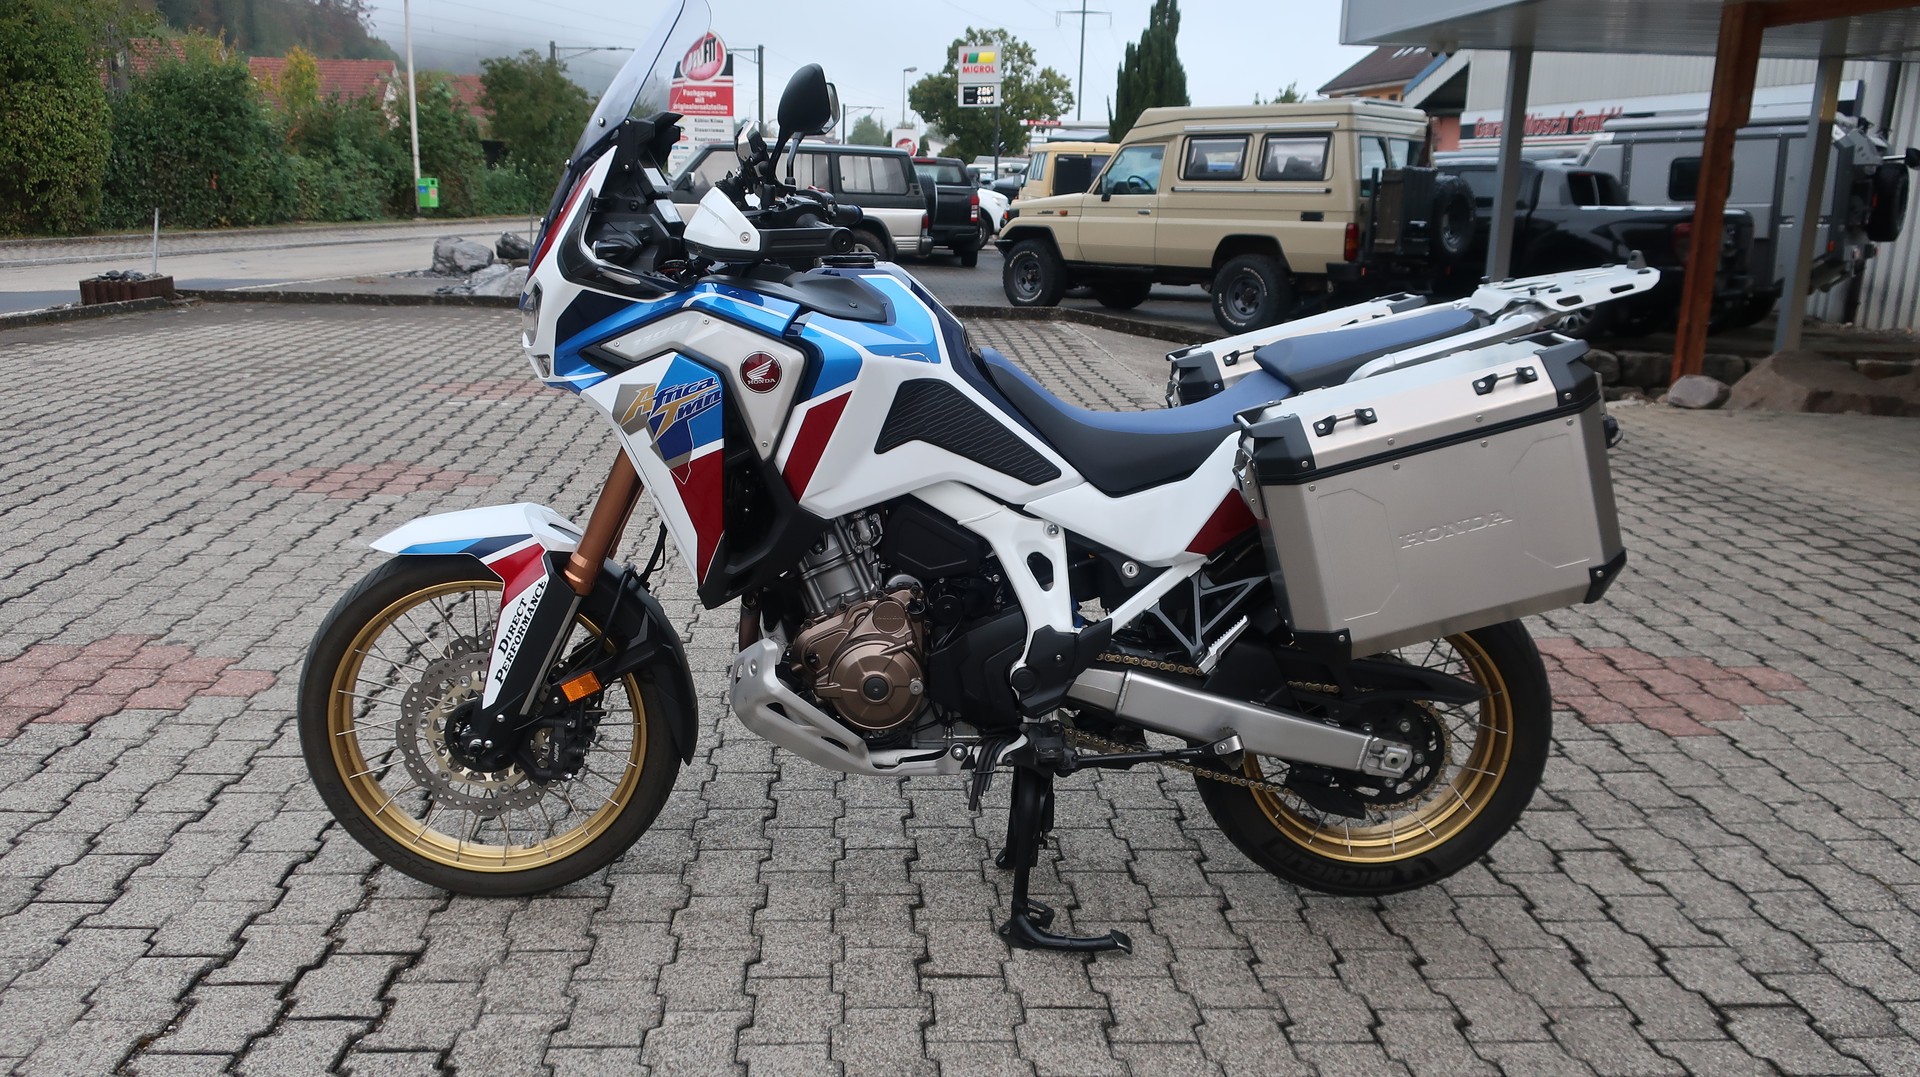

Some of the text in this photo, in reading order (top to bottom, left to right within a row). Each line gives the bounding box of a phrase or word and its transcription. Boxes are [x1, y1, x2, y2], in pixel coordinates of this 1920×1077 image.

[962, 65, 996, 73] MIGROL
[619, 377, 719, 426] Africa
[1399, 510, 1513, 549] HONDA
[1265, 842, 1394, 886] MICHELIN
